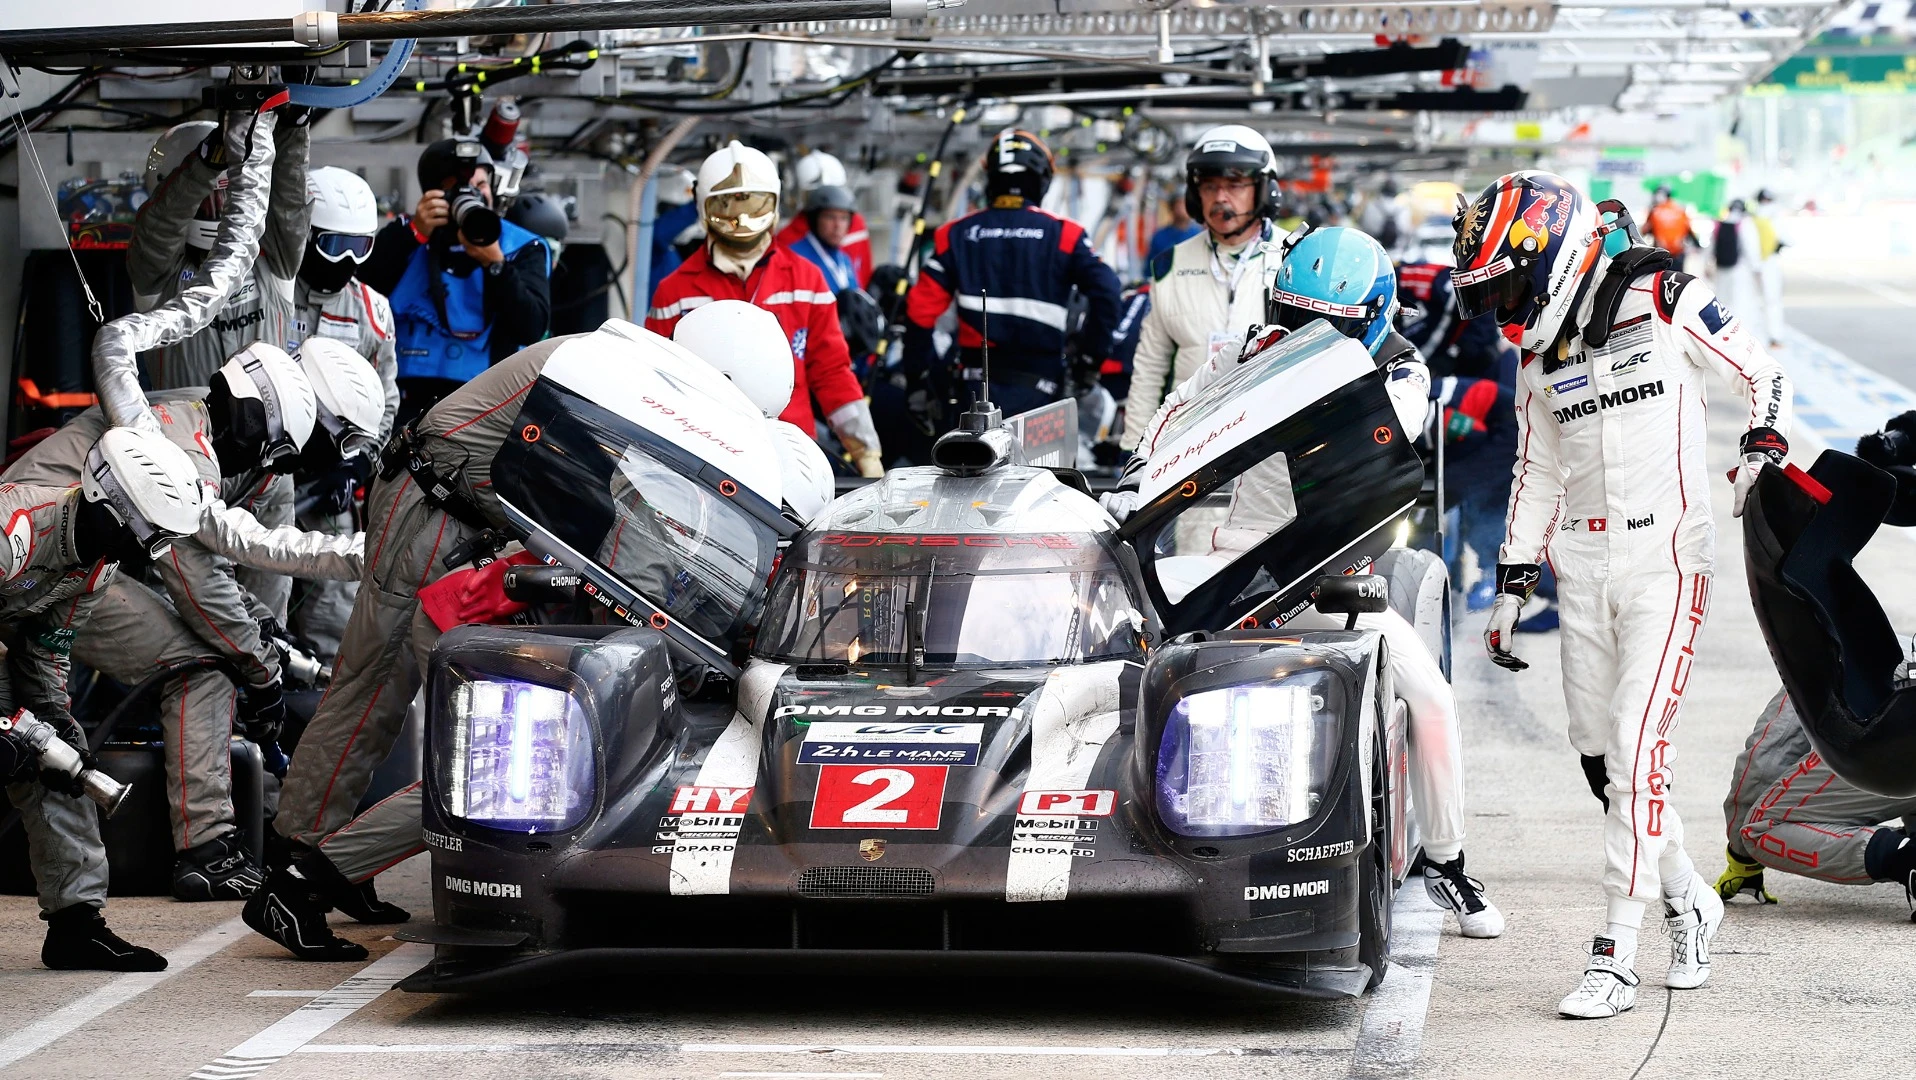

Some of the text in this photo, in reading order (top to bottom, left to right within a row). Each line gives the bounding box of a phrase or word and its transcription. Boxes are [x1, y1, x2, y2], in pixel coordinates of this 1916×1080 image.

[1551, 249, 1578, 297] DMG MORI
[1272, 289, 1360, 316] ORSCHE
[1531, 338, 1545, 351] ORI
[1610, 351, 1652, 372] WEC
[1557, 377, 1587, 391] MICHELIN
[260, 385, 276, 420] uvex
[641, 396, 676, 415] 919
[1552, 379, 1665, 425] DMG MORI
[1151, 454, 1180, 481] 919
[108, 487, 135, 523] uvex
[60, 504, 70, 558] CHOPARD
[1626, 513, 1655, 531] Neel
[815, 534, 1080, 549] PORSCHE
[1353, 555, 1373, 572] Lieb
[594, 591, 614, 608] Jani
[625, 611, 643, 628] Lieb
[1280, 599, 1310, 623] Dumas
[773, 704, 1024, 721] DMG MORI
[856, 724, 966, 735] WEC
[862, 749, 894, 758] LE
[896, 750, 967, 759] MANS
[672, 787, 752, 812] HY
[841, 768, 916, 823] 2
[1036, 793, 1099, 811] P1
[660, 817, 720, 827] Mobil
[1015, 819, 1075, 829] Mobil
[1038, 834, 1095, 842] MICHELIN
[652, 845, 735, 853] CHOPARD
[1011, 847, 1094, 857] CHOPARD
[1286, 839, 1354, 863] SCHAEFFLER
[445, 875, 522, 898] DMG MORI
[1243, 879, 1329, 901] DMG MORI
